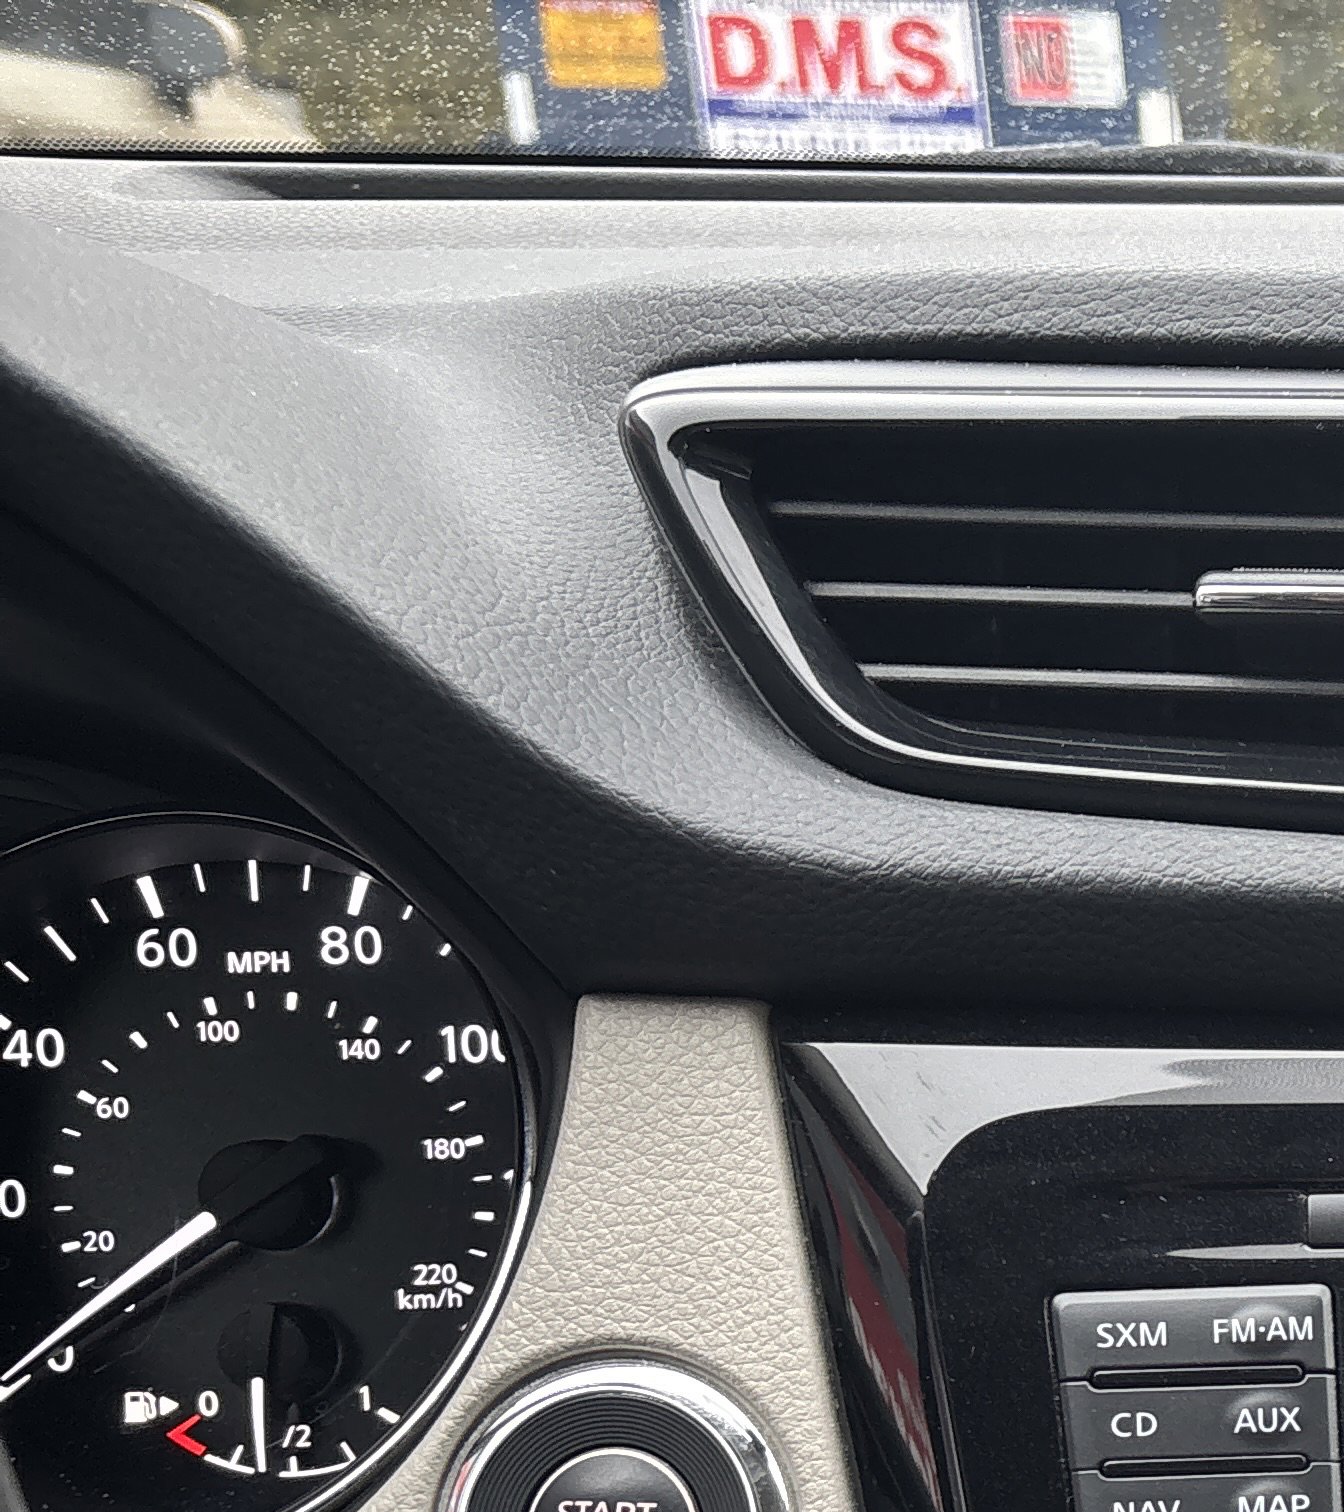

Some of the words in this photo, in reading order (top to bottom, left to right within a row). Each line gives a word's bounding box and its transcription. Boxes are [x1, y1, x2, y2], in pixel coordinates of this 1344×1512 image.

[136, 928, 198, 968] 60
[320, 926, 382, 967] 80
[227, 951, 291, 974] MPH
[197, 1020, 240, 1044] 100
[2, 1028, 65, 1068] 40
[339, 1038, 381, 1062] 140
[96, 1097, 129, 1120] 60
[423, 1138, 466, 1160] 180
[0, 1179, 26, 1218] 0
[82, 1230, 115, 1252] 20
[412, 1263, 458, 1286] 220
[398, 1287, 464, 1311] km/h
[1096, 1322, 1168, 1348] SXM
[198, 1390, 219, 1417] 0
[358, 1384, 371, 1411] 1
[1110, 1412, 1158, 1438] CD
[1234, 1406, 1301, 1433] AUX
